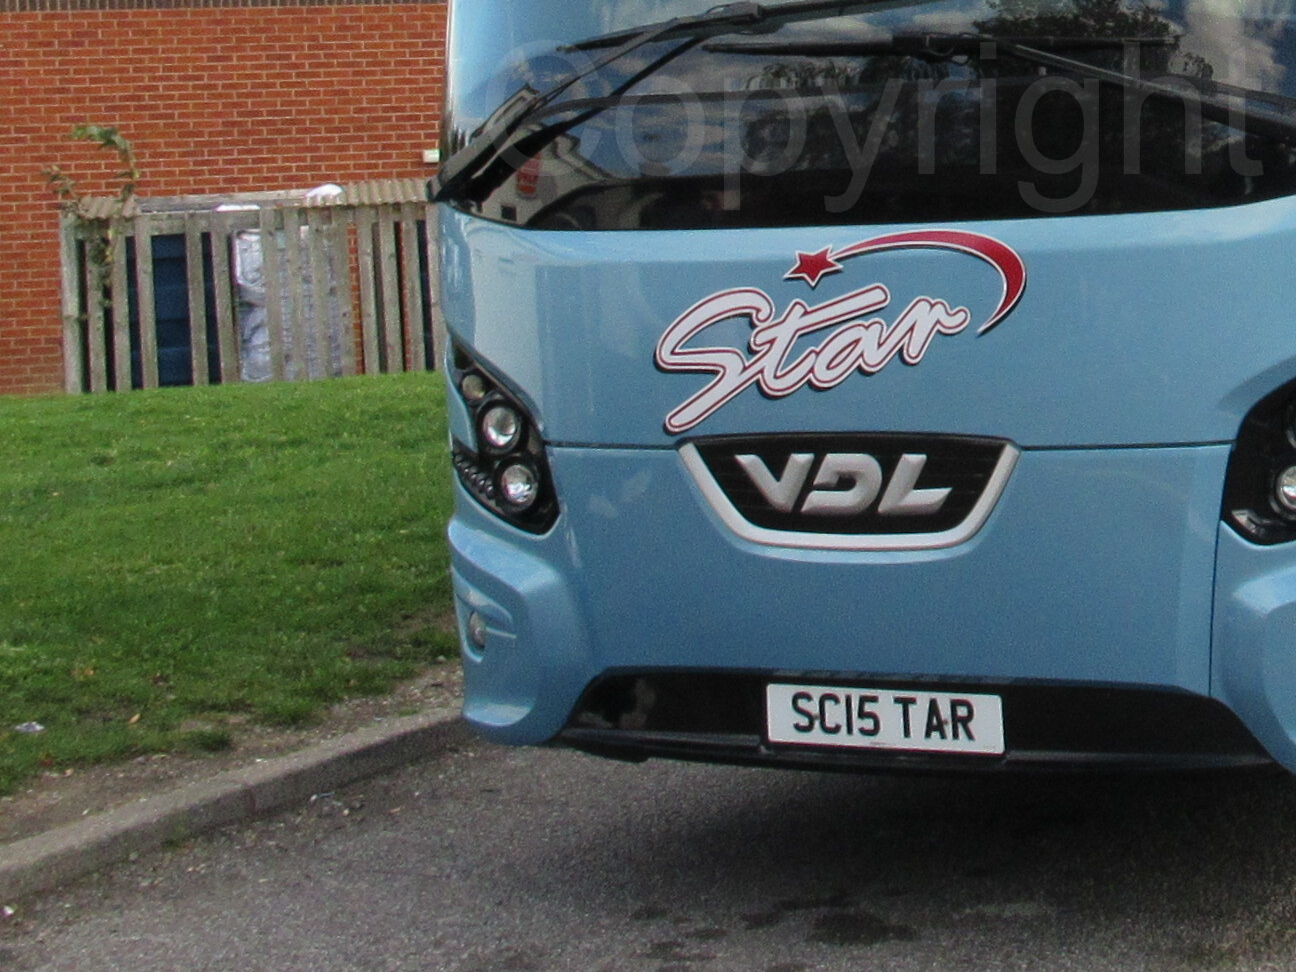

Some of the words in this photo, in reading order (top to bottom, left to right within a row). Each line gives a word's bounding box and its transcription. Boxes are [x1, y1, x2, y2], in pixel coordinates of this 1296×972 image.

[654, 282, 970, 434] Star
[733, 452, 952, 515] VDL
[791, 690, 881, 738] SC15
[893, 694, 976, 742] TAR
